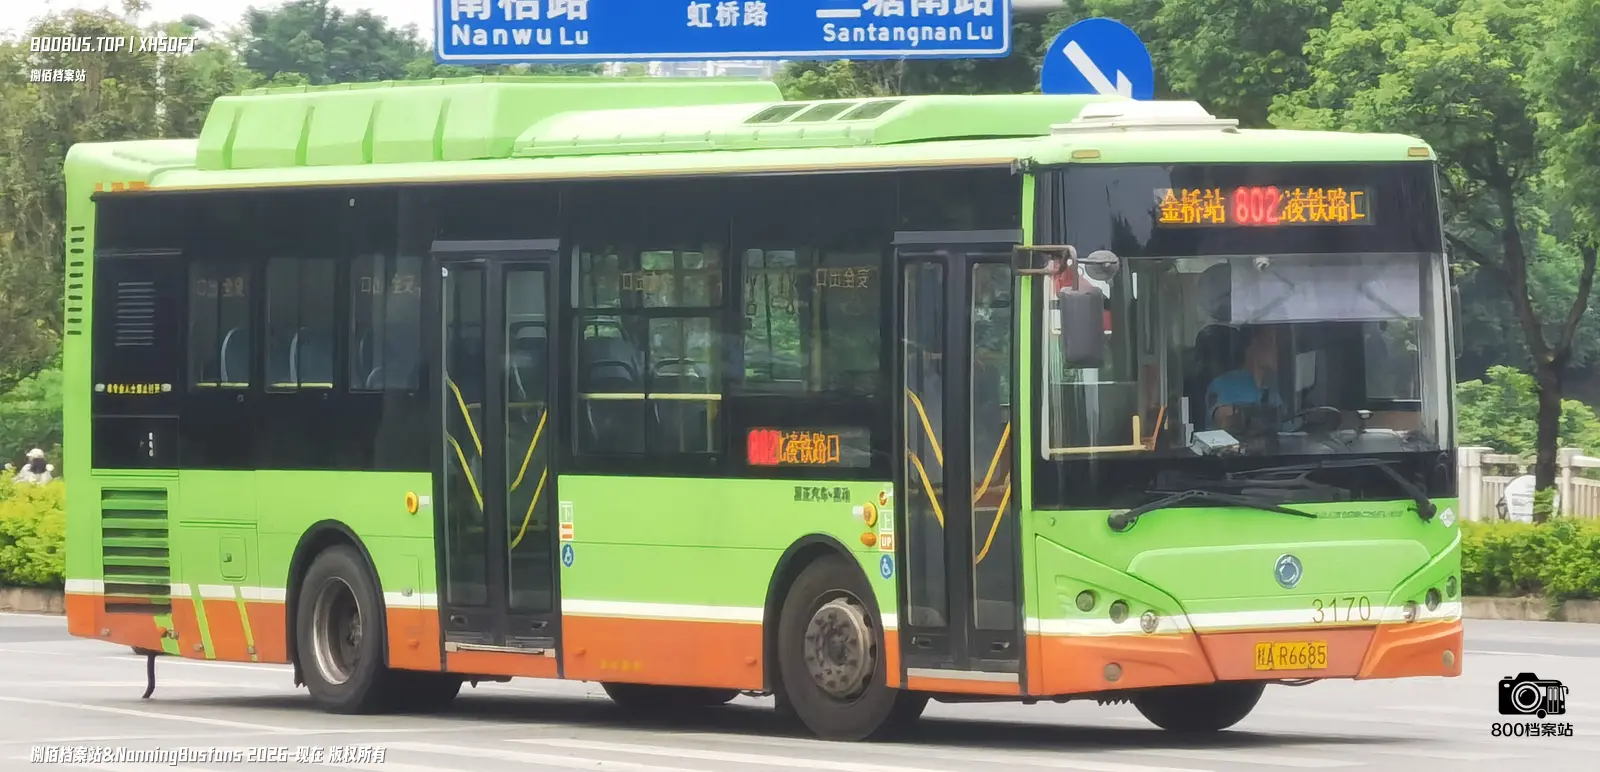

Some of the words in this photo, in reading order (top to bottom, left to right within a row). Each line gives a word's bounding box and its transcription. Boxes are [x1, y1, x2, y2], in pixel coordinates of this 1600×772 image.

[686, 1, 768, 28] 虹桥路
[452, 24, 552, 46] Nanwu
[559, 26, 589, 45] Lu
[823, 23, 962, 47] Santangnan
[966, 21, 993, 41] Lu
[1159, 188, 1225, 223] 金桥站
[1233, 185, 1281, 225] 802
[881, 536, 893, 547] UP
[1311, 596, 1371, 624] 3170
